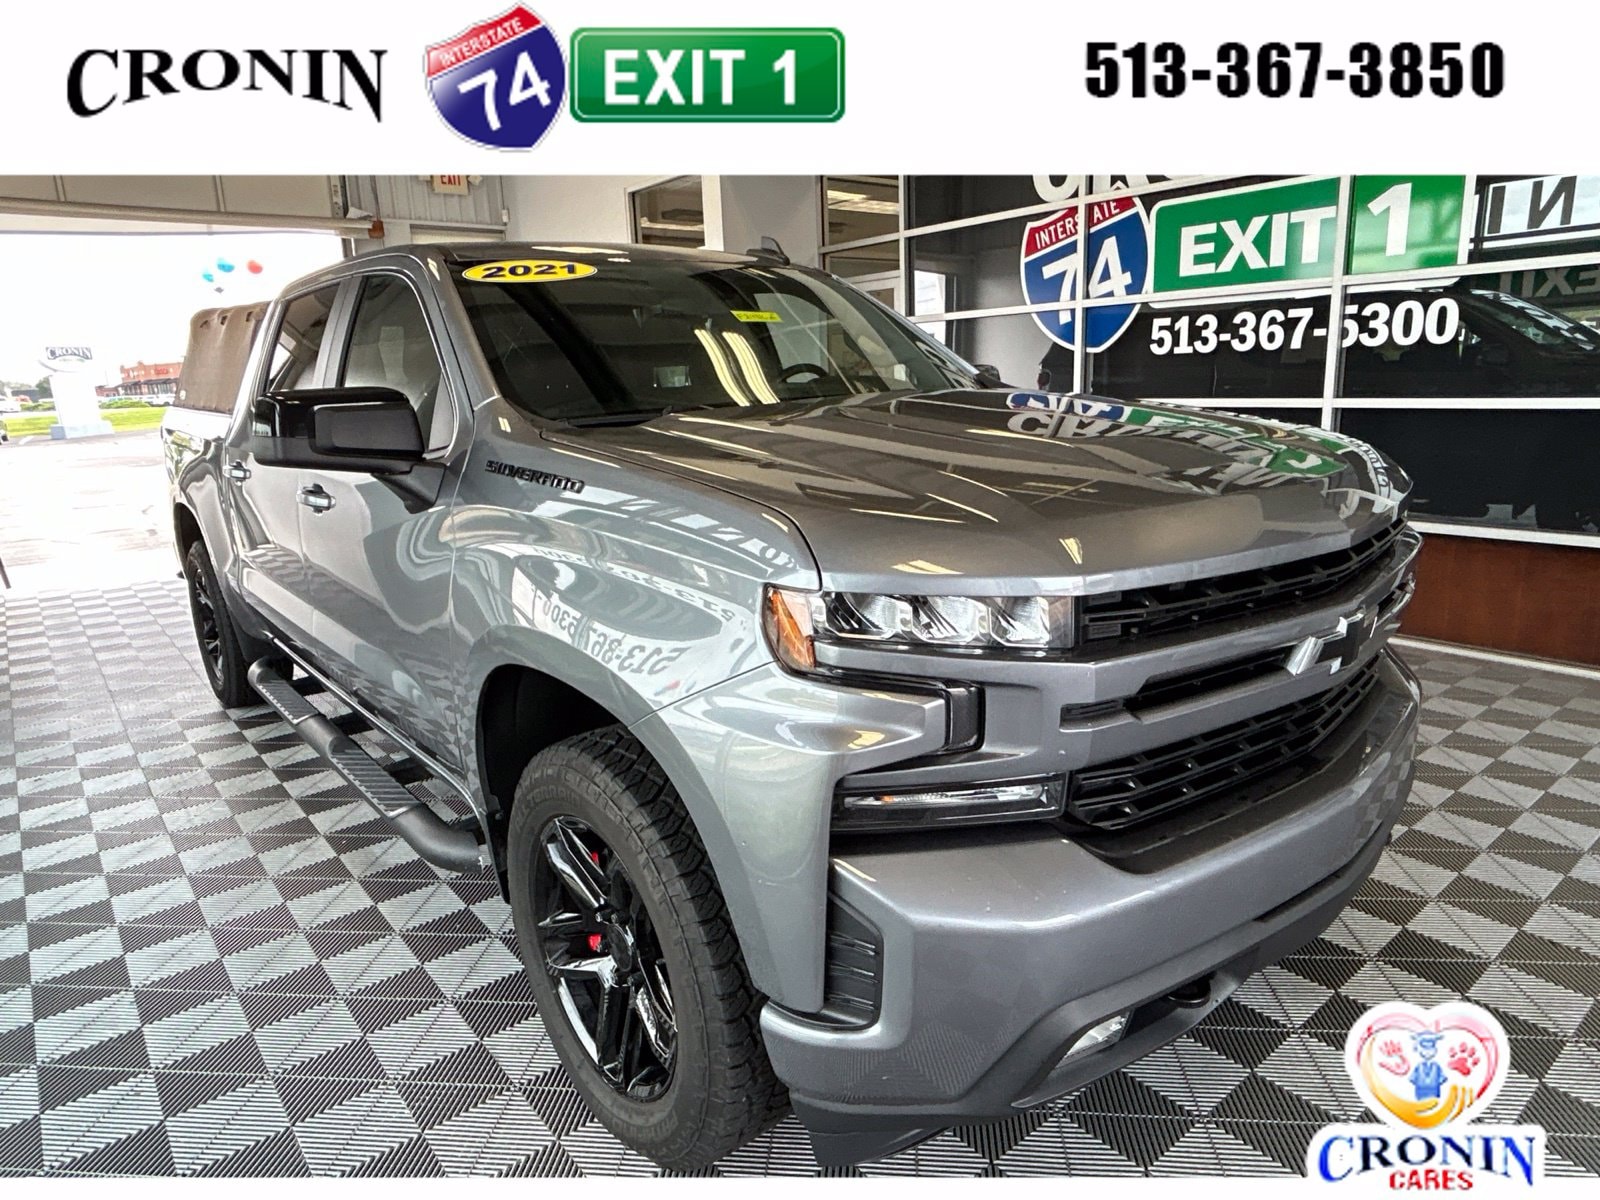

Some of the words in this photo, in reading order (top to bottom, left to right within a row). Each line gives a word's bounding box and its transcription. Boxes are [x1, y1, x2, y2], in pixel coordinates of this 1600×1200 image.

[1034, 200, 1121, 250] INTERSATE
[1179, 205, 1337, 277] EXIT
[1367, 182, 1412, 256] 1
[481, 264, 577, 279] 2021
[1042, 235, 1132, 326] 74
[1150, 298, 1460, 356] 513-367-5300
[485, 460, 584, 494] SILVERADO
